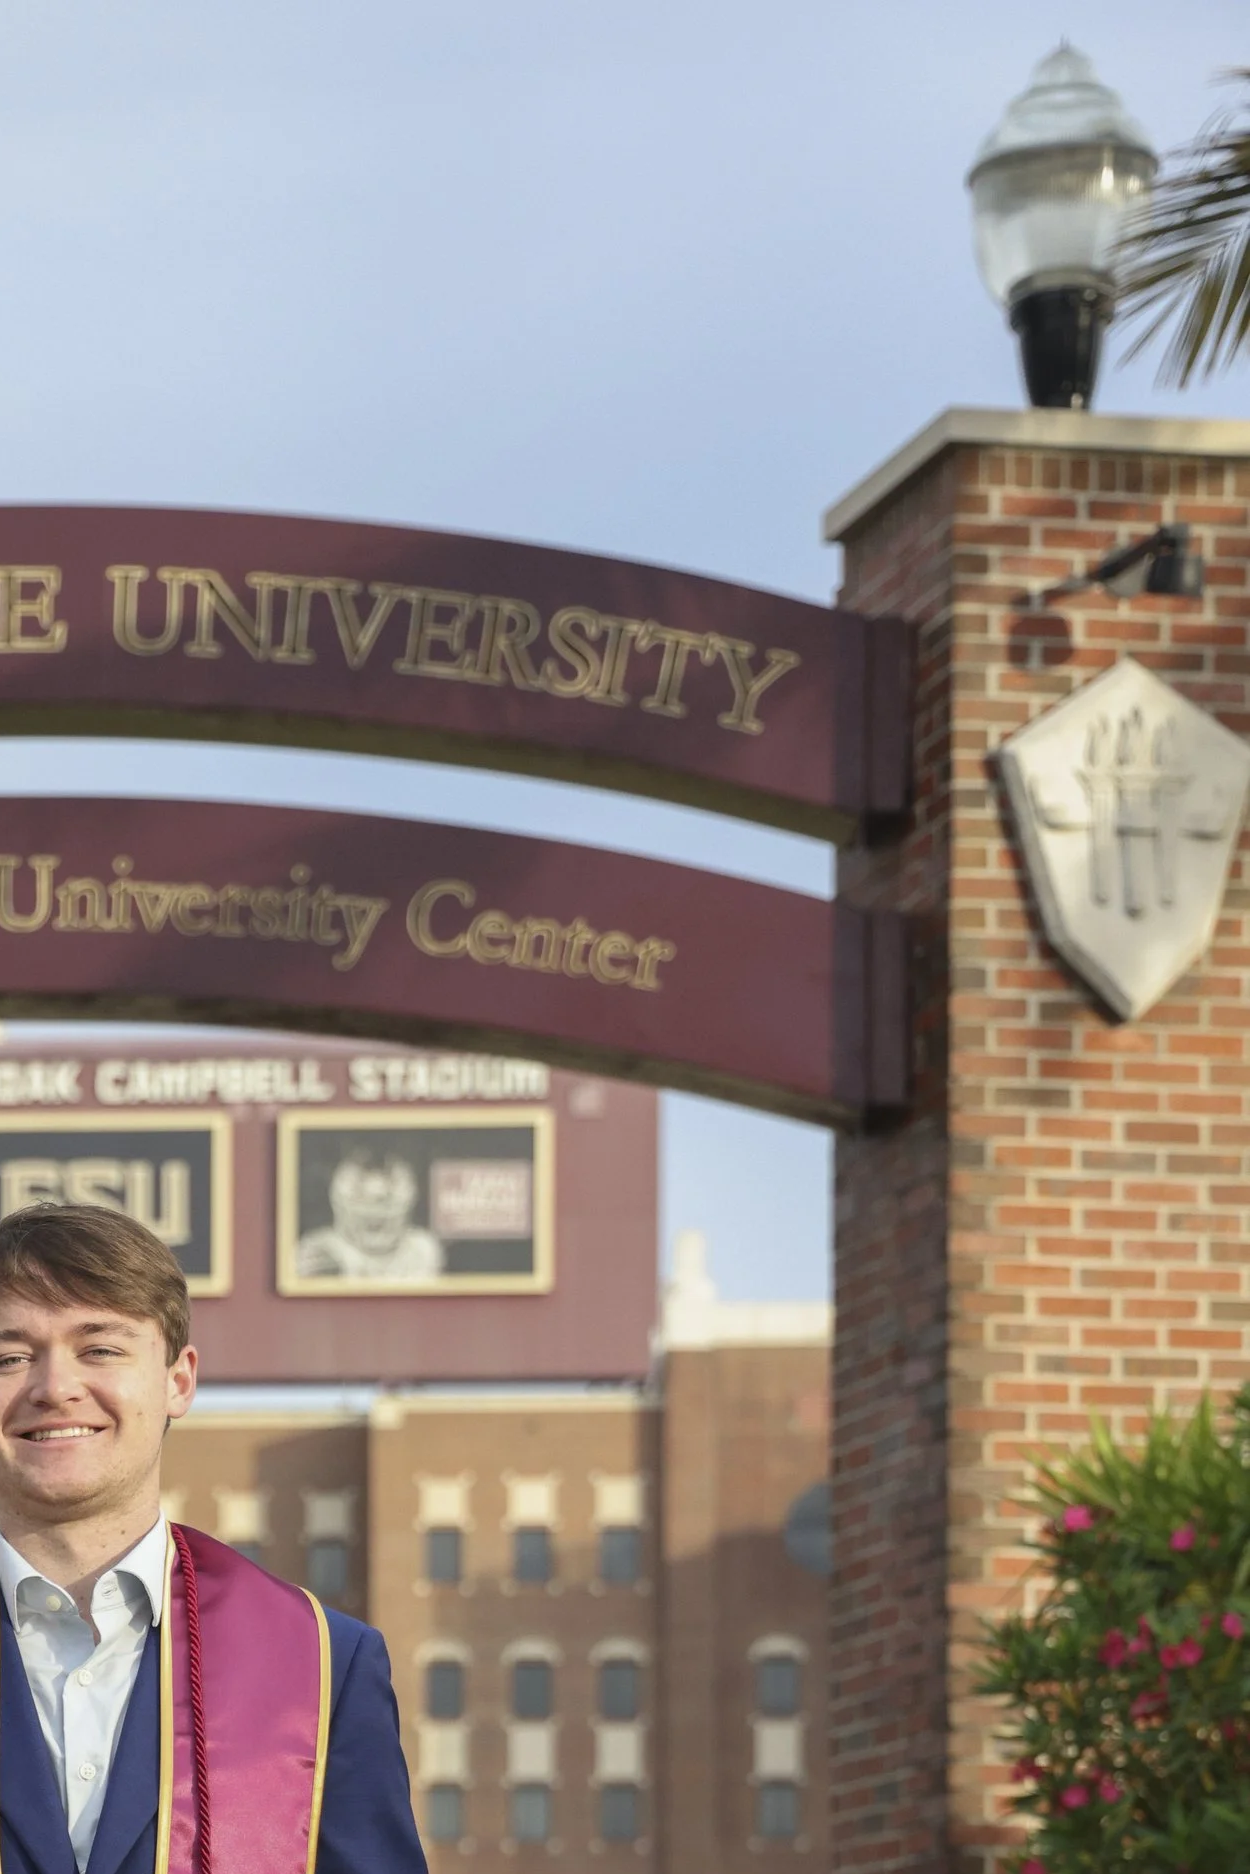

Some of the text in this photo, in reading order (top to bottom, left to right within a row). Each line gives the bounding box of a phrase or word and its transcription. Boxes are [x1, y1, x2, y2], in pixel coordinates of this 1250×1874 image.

[105, 564, 800, 735] UNIVERSITY
[405, 879, 676, 992] Center
[94, 1058, 337, 1105] CAMPBELL
[348, 1055, 548, 1101] STADIUM
